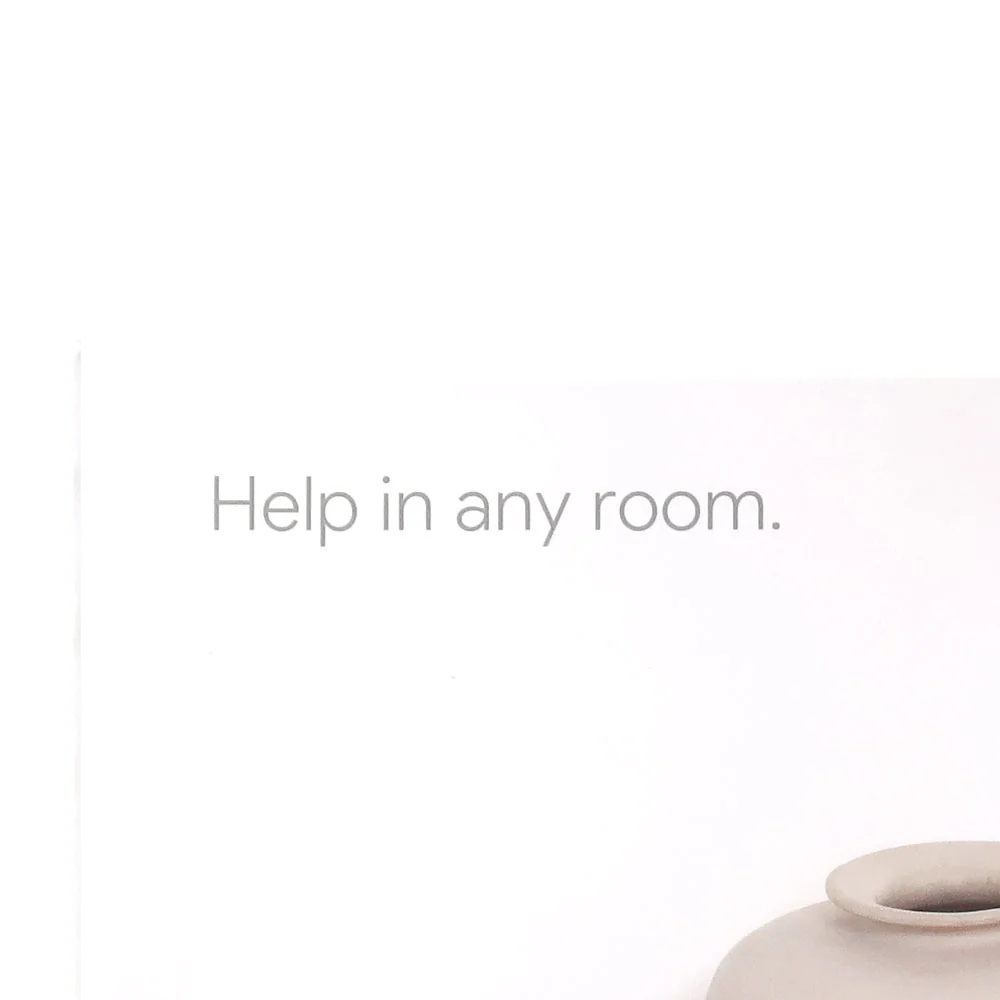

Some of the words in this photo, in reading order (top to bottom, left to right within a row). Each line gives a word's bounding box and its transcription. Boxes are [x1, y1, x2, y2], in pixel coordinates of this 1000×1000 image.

[213, 475, 358, 548] Help
[382, 475, 432, 531] in
[456, 490, 572, 548] any
[594, 490, 781, 532] room.
